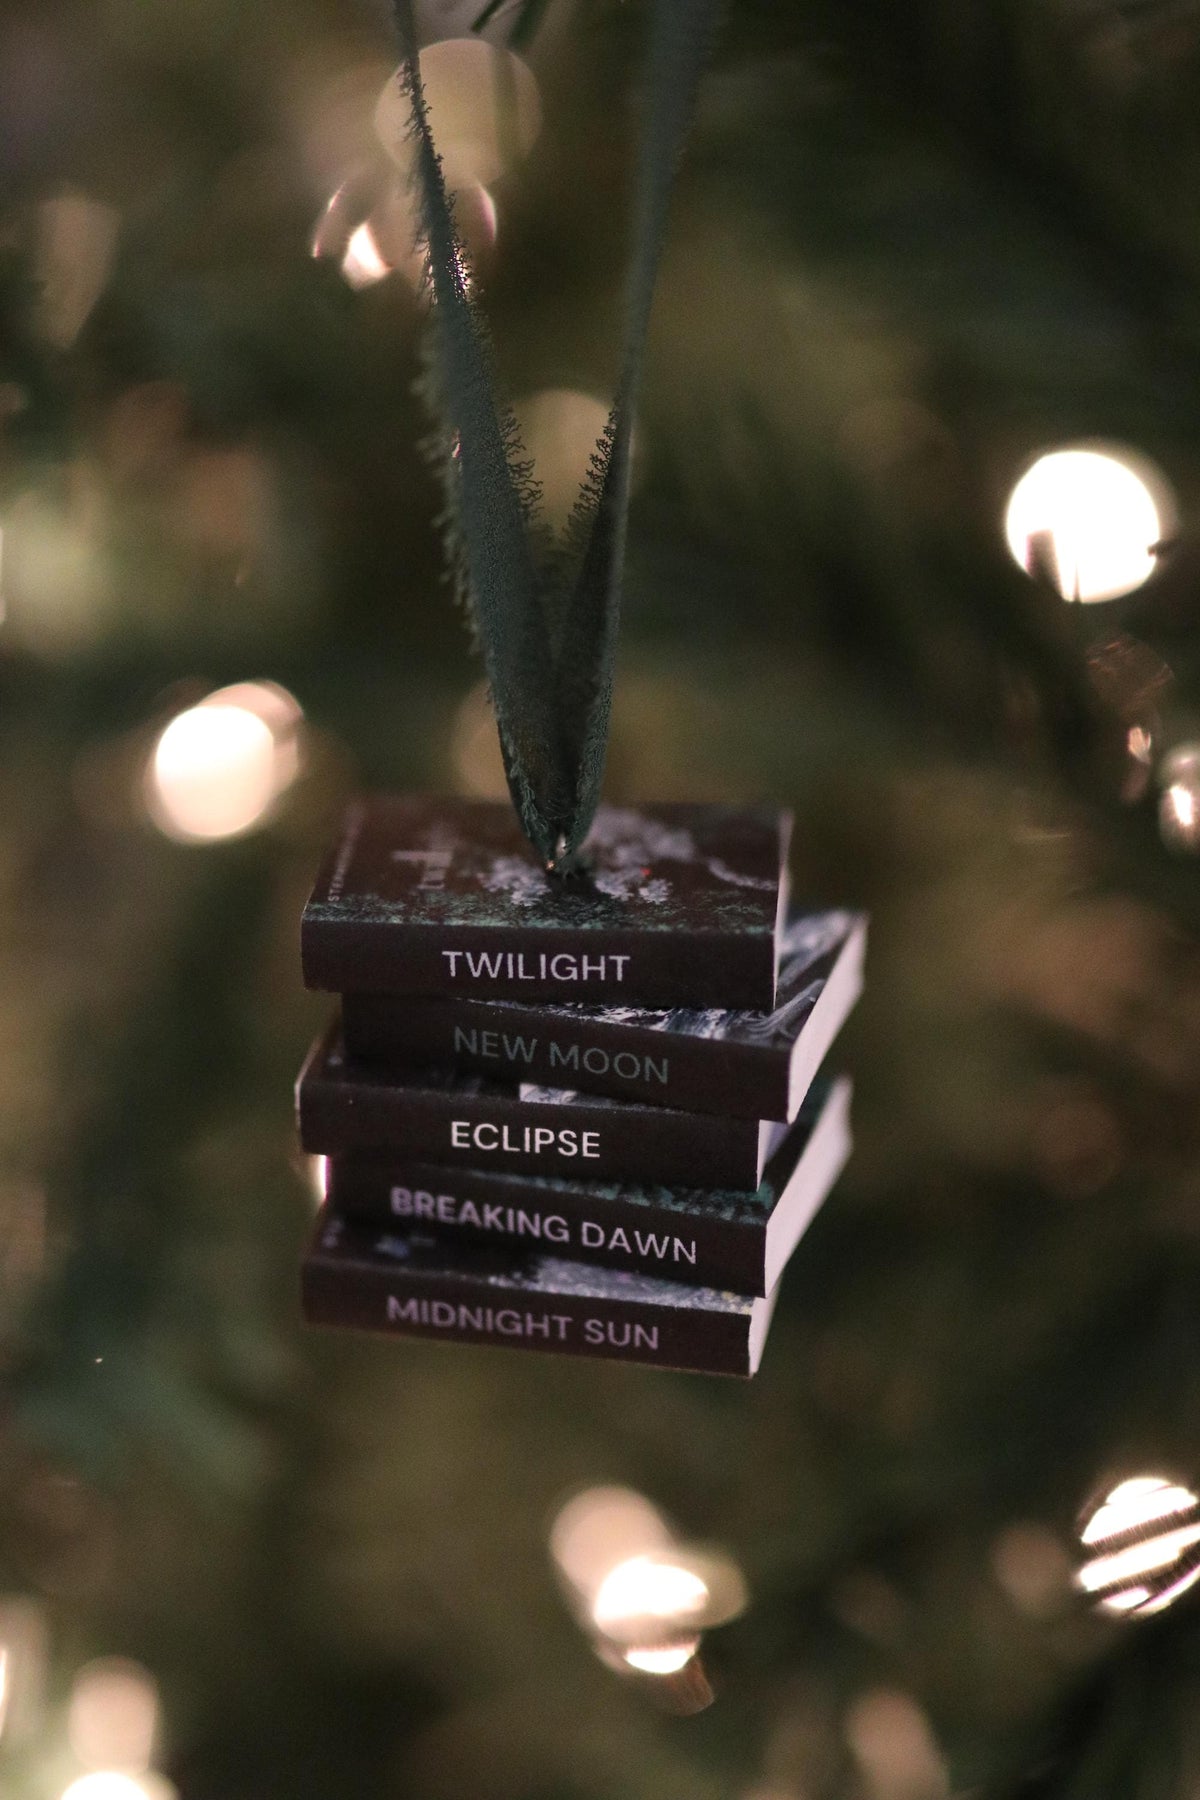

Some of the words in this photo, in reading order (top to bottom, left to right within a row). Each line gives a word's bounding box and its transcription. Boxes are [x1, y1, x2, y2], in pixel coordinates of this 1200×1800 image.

[442, 950, 631, 982] TWILIGHT
[453, 1026, 537, 1064] NEW
[549, 1047, 669, 1084] MOON
[451, 1121, 601, 1158] ECLIPSE
[390, 1186, 570, 1244] BREAKING
[581, 1222, 697, 1265] DAWN
[386, 1294, 574, 1343] MIDNIGHT
[584, 1319, 659, 1350] SUN
